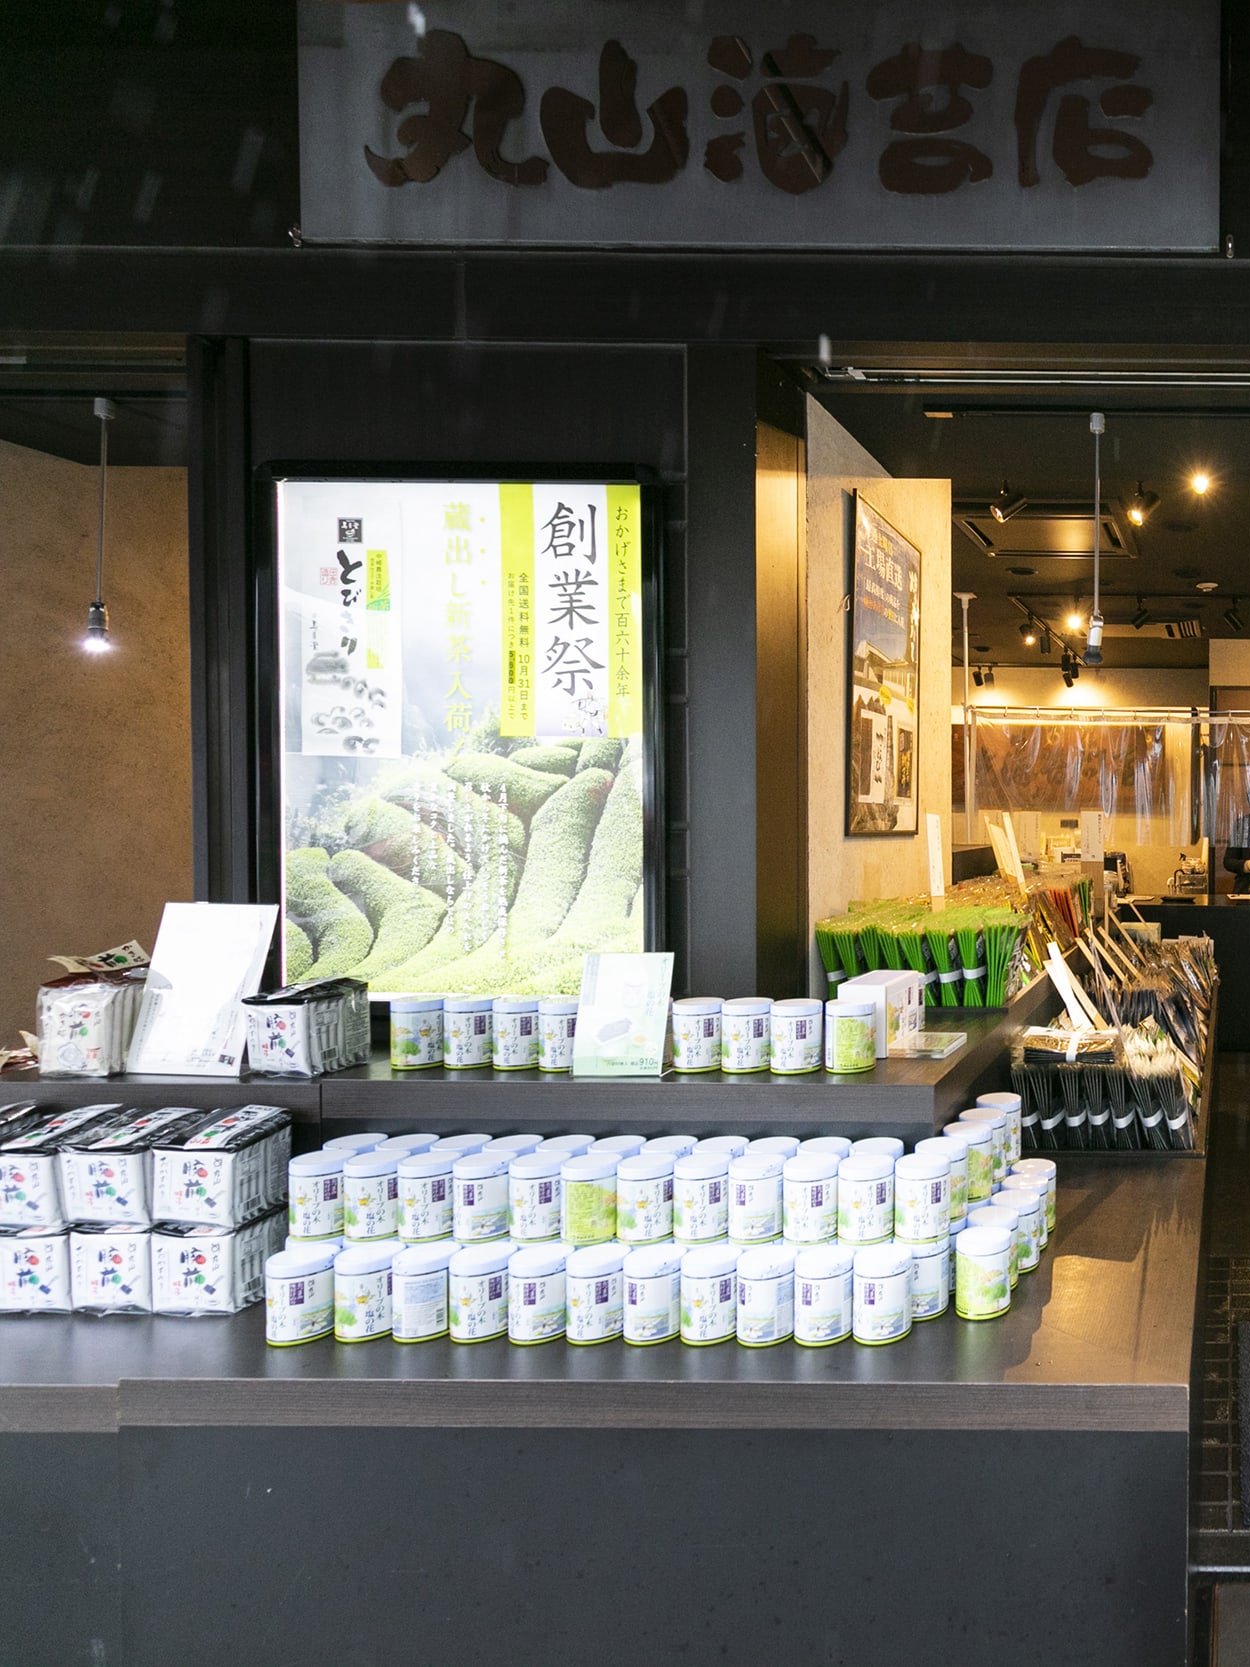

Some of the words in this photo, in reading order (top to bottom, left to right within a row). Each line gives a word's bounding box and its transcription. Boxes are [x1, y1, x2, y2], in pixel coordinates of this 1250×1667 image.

[363, 29, 1154, 195] 丸山海苔店
[518, 572, 529, 648] 全国送料無料
[541, 502, 606, 696] 創業祭
[615, 506, 632, 697] おかげさまで百六十余年
[518, 653, 530, 720] 10月31日まで
